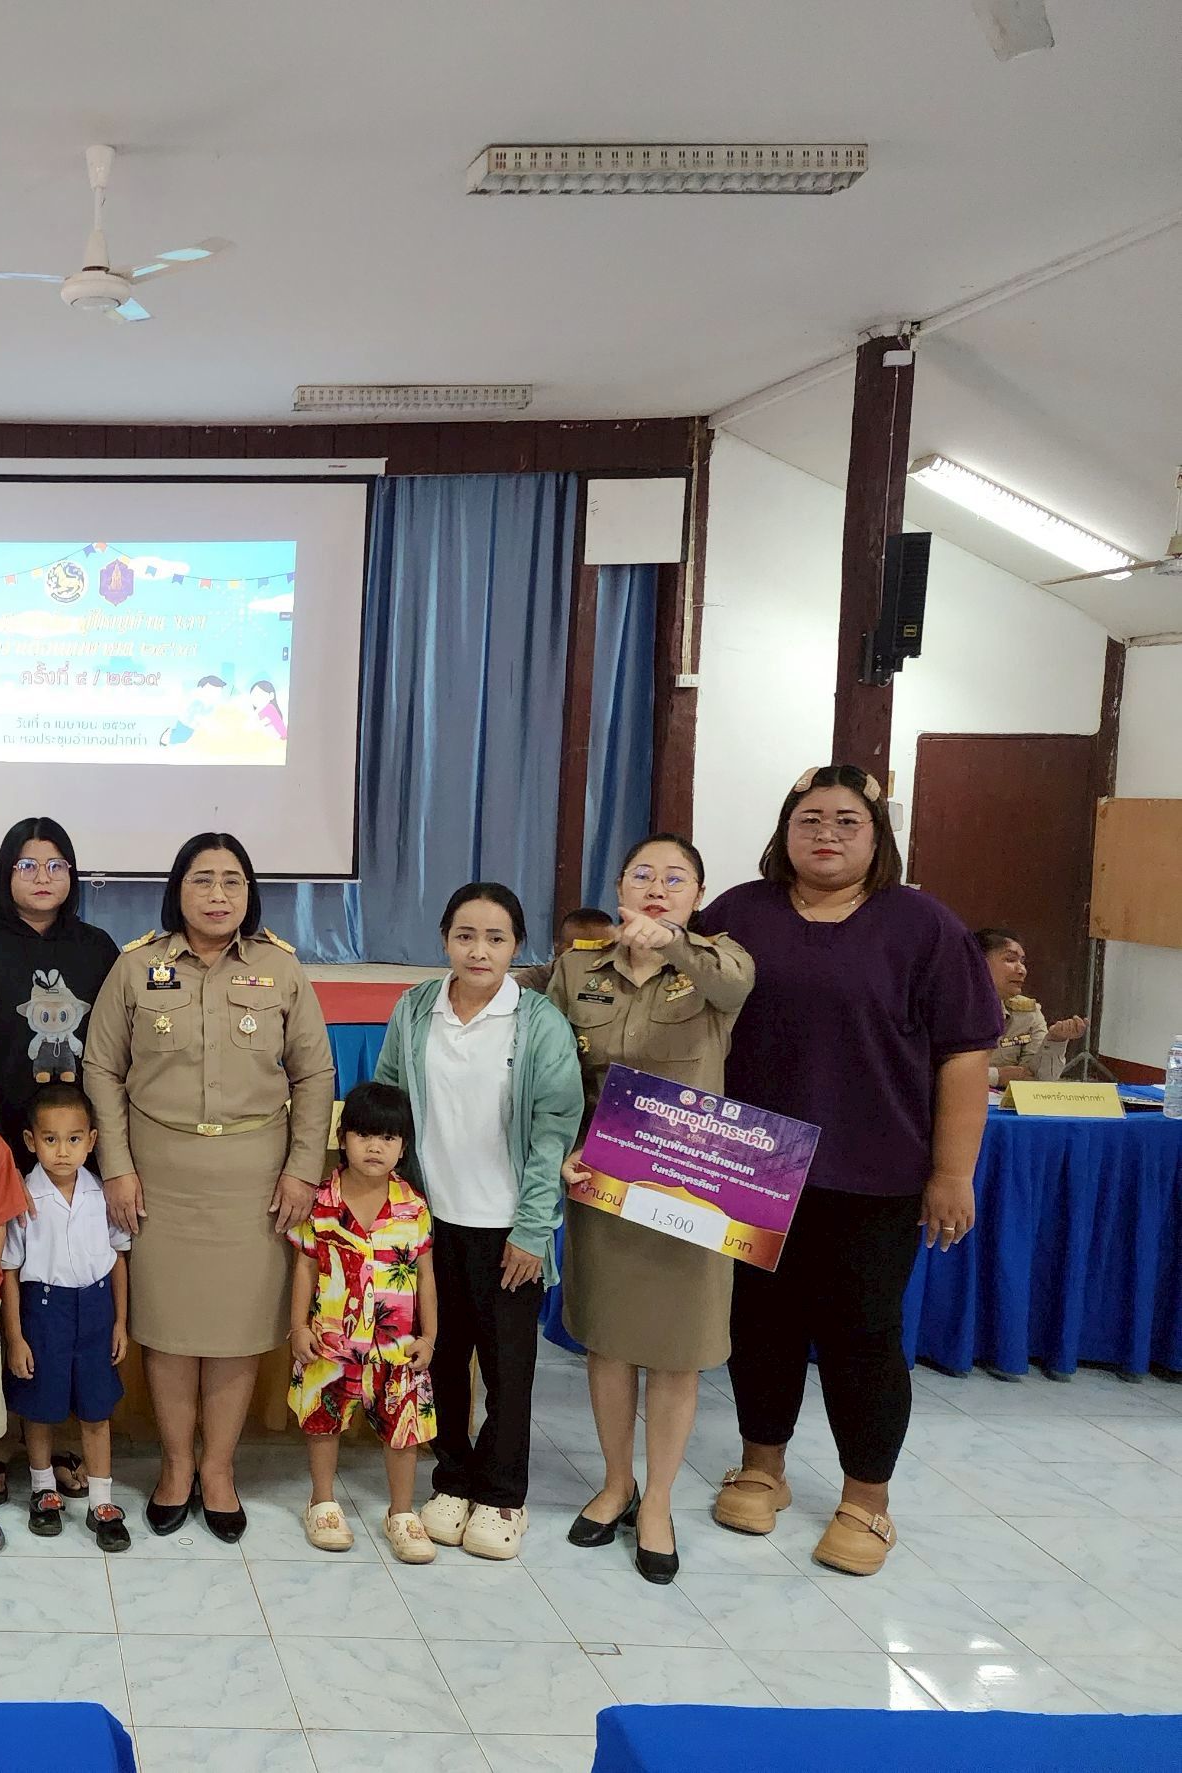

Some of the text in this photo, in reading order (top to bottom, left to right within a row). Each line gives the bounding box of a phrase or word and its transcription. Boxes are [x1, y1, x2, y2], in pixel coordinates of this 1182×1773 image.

[20, 659, 69, 686] ครั้งที่
[92, 668, 101, 687] /
[15, 713, 39, 729] วันที่
[634, 1096, 775, 1152] มอบทุนอุปการะเด็ก
[634, 1129, 756, 1177] กองทุนพัฒนาเด็กชนบท
[650, 1207, 695, 1235] 1,500
[724, 1234, 754, 1255] บาท
